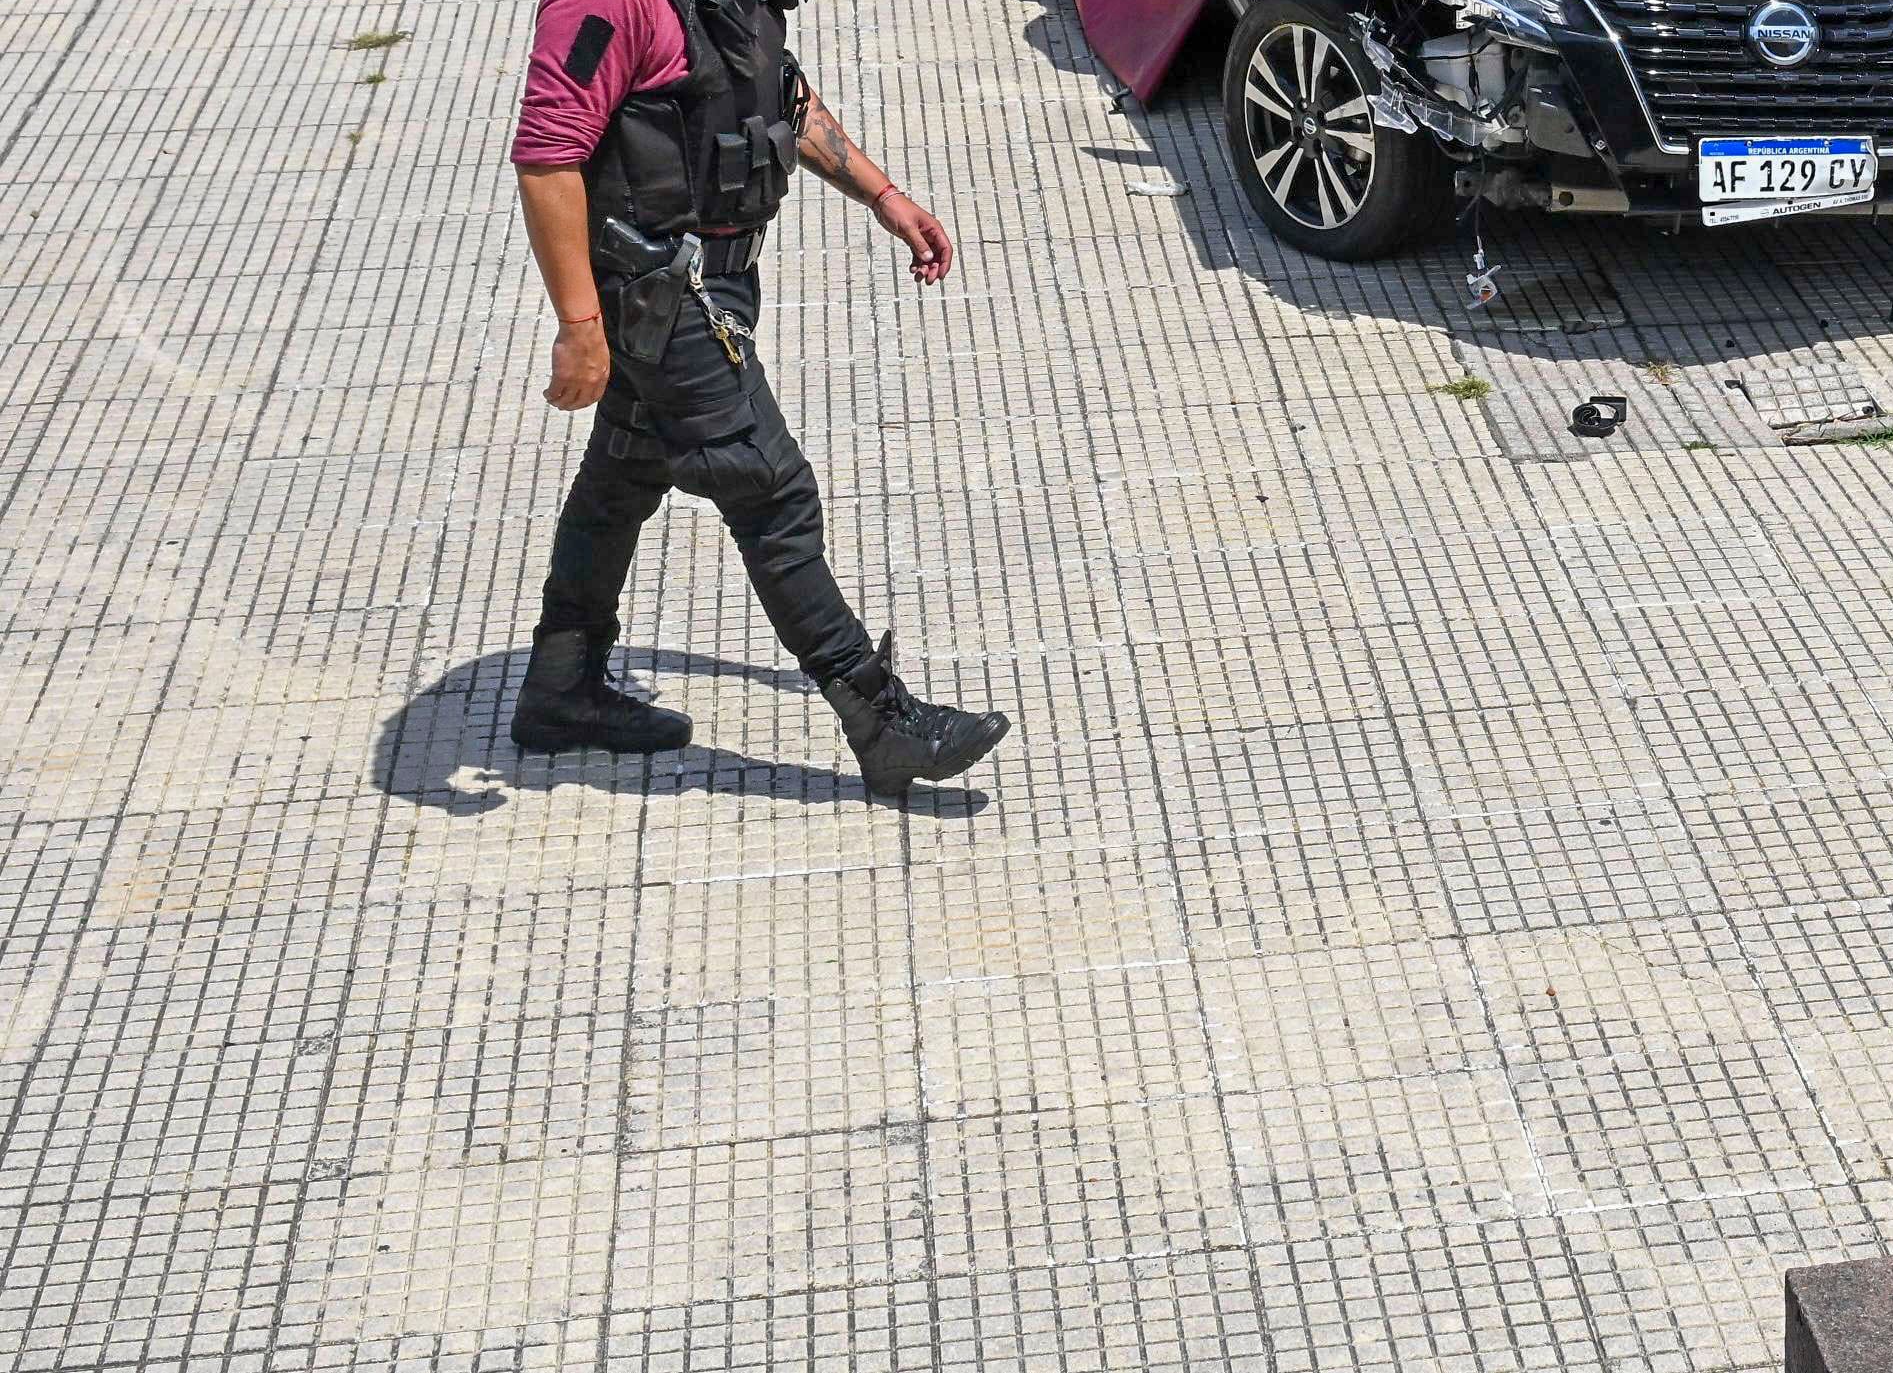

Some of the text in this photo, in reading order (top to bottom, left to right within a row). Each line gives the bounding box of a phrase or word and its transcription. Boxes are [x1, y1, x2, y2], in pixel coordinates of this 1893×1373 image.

[1757, 29, 1811, 39] NISSAN
[1748, 146, 1830, 155] REPÚBLICA ARGENTINA
[1713, 158, 1867, 194] AF 129 CY
[1772, 201, 1822, 216] AUTOGEN
